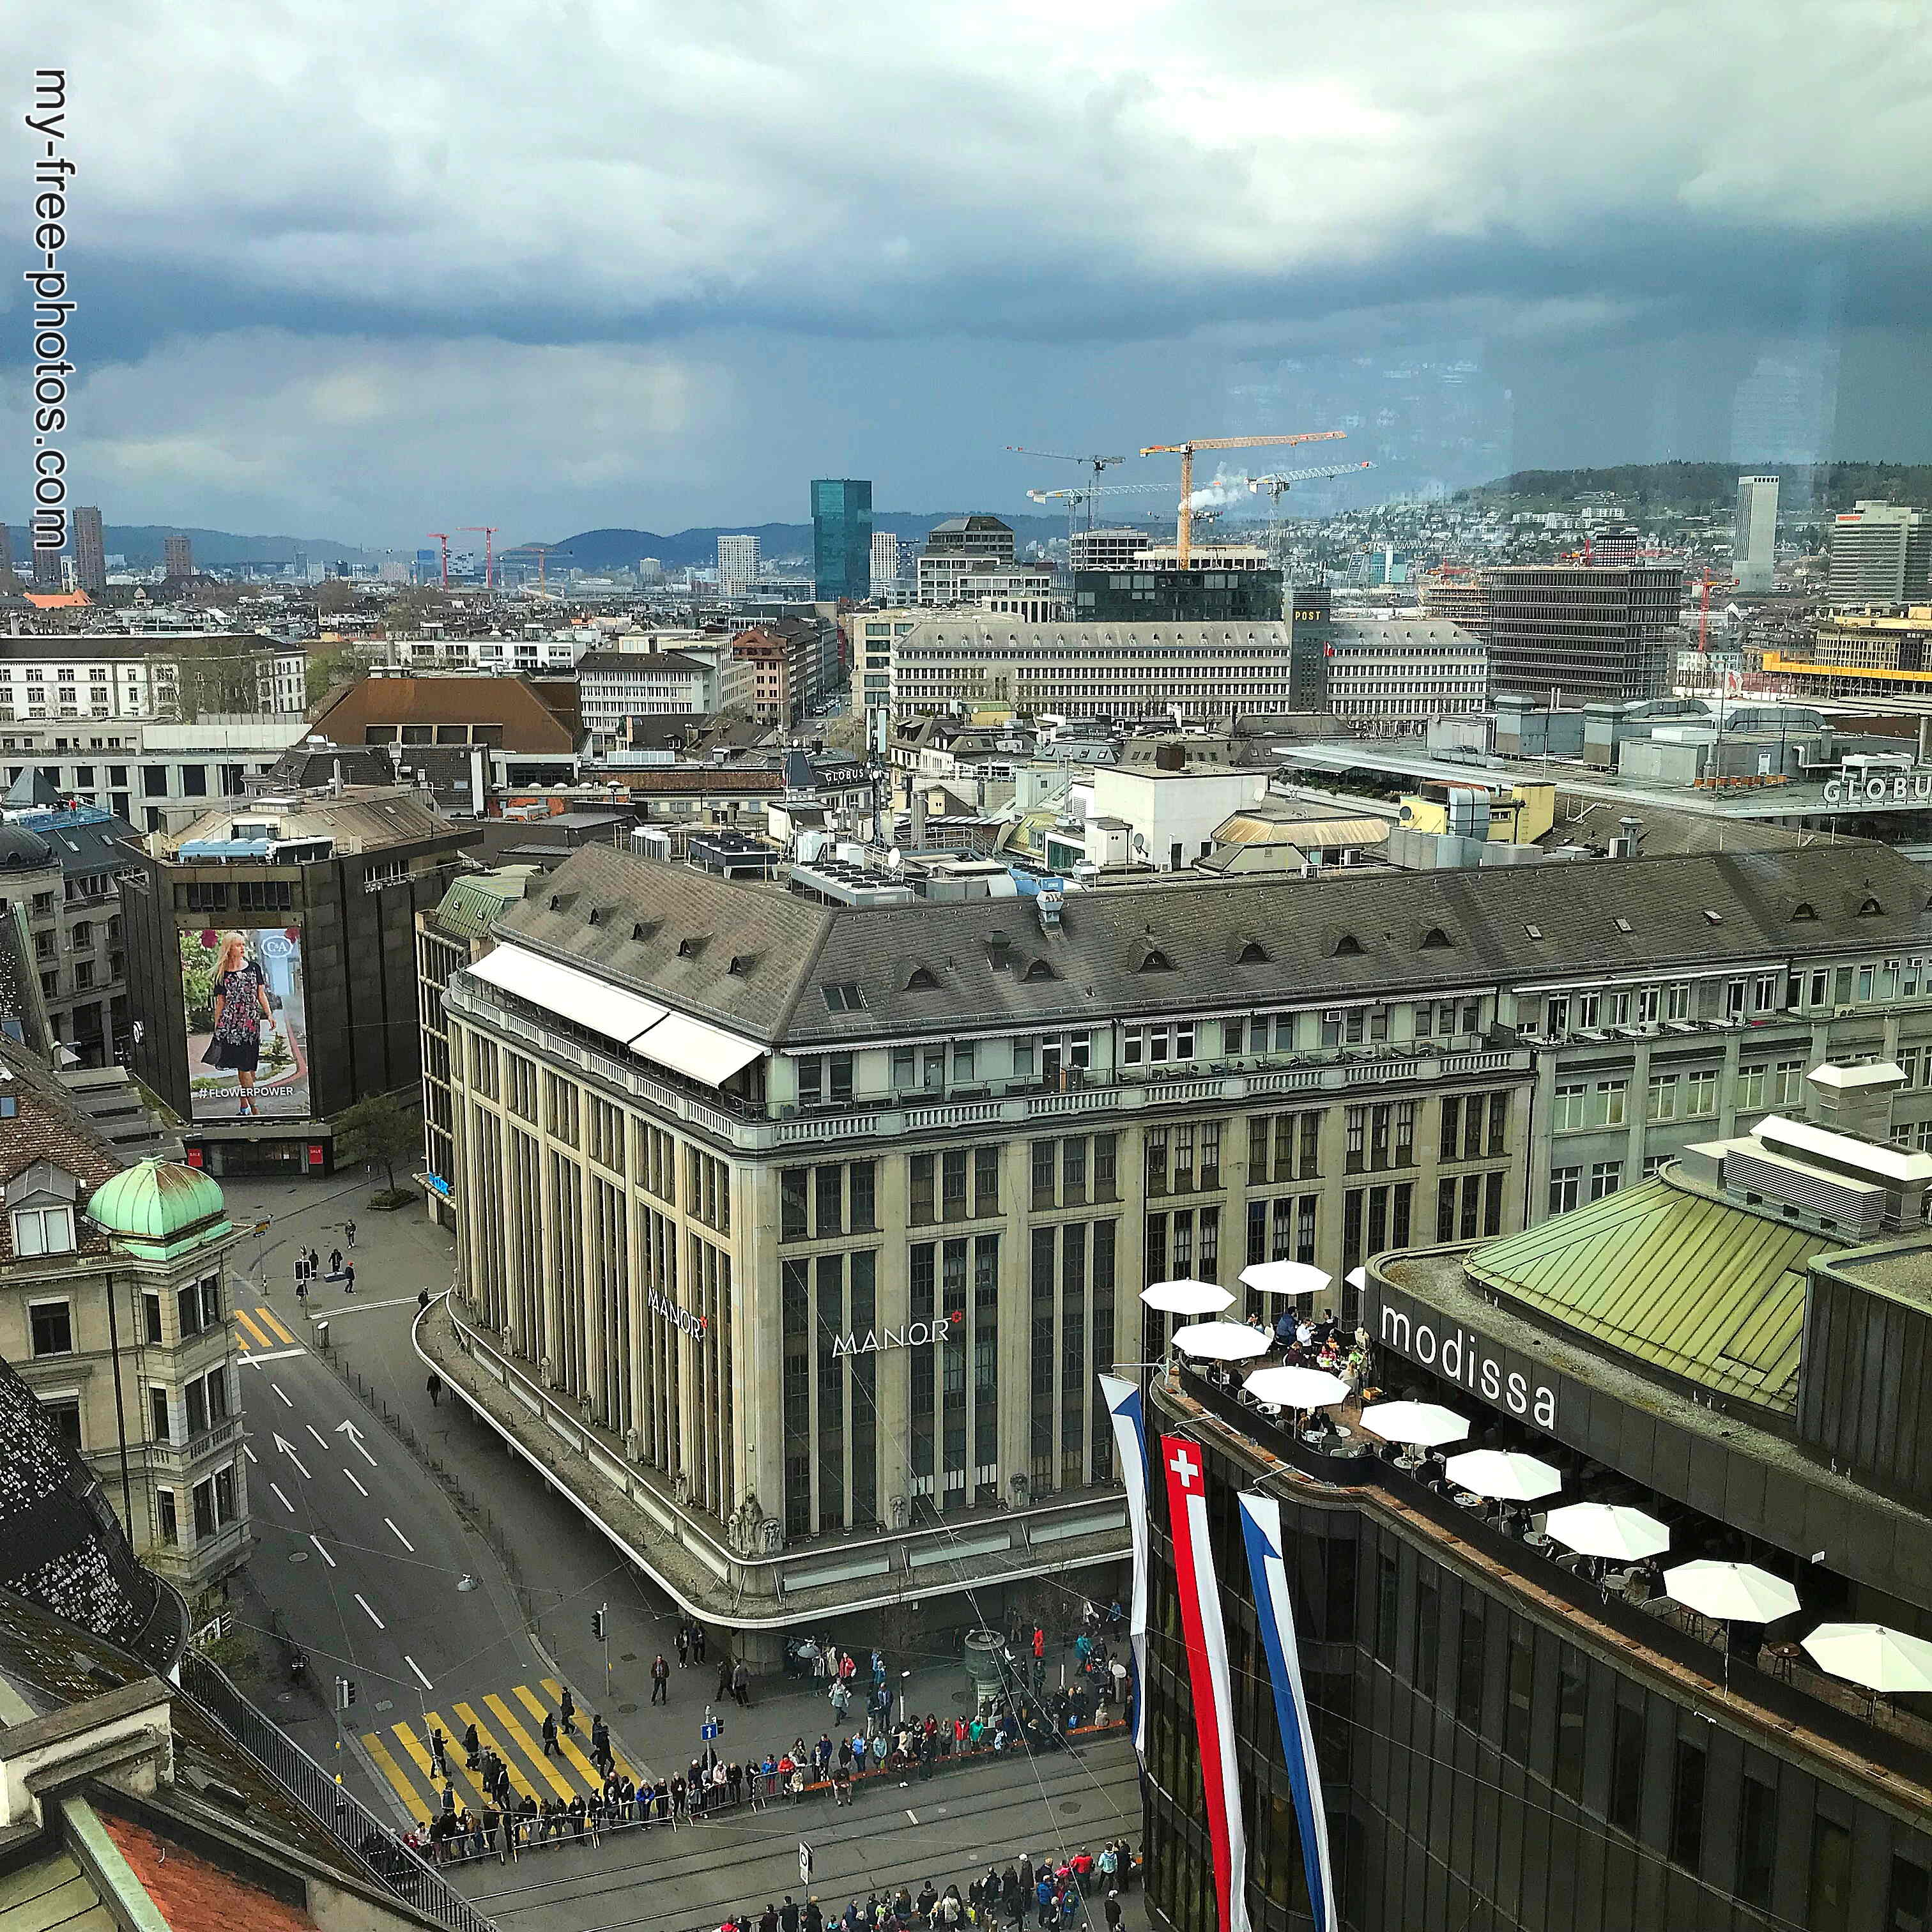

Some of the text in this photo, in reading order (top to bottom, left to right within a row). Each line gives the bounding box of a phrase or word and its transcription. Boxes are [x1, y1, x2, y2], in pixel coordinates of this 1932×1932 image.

[1295, 611, 1321, 620] POST
[825, 768, 864, 782] GLOBUS
[1823, 776, 1932, 802] GLOBU
[199, 1087, 293, 1099] #FLOWERPOWER
[648, 1285, 701, 1342] MANOR
[832, 1319, 949, 1358] MANOR
[1381, 1304, 1555, 1430] modissa
